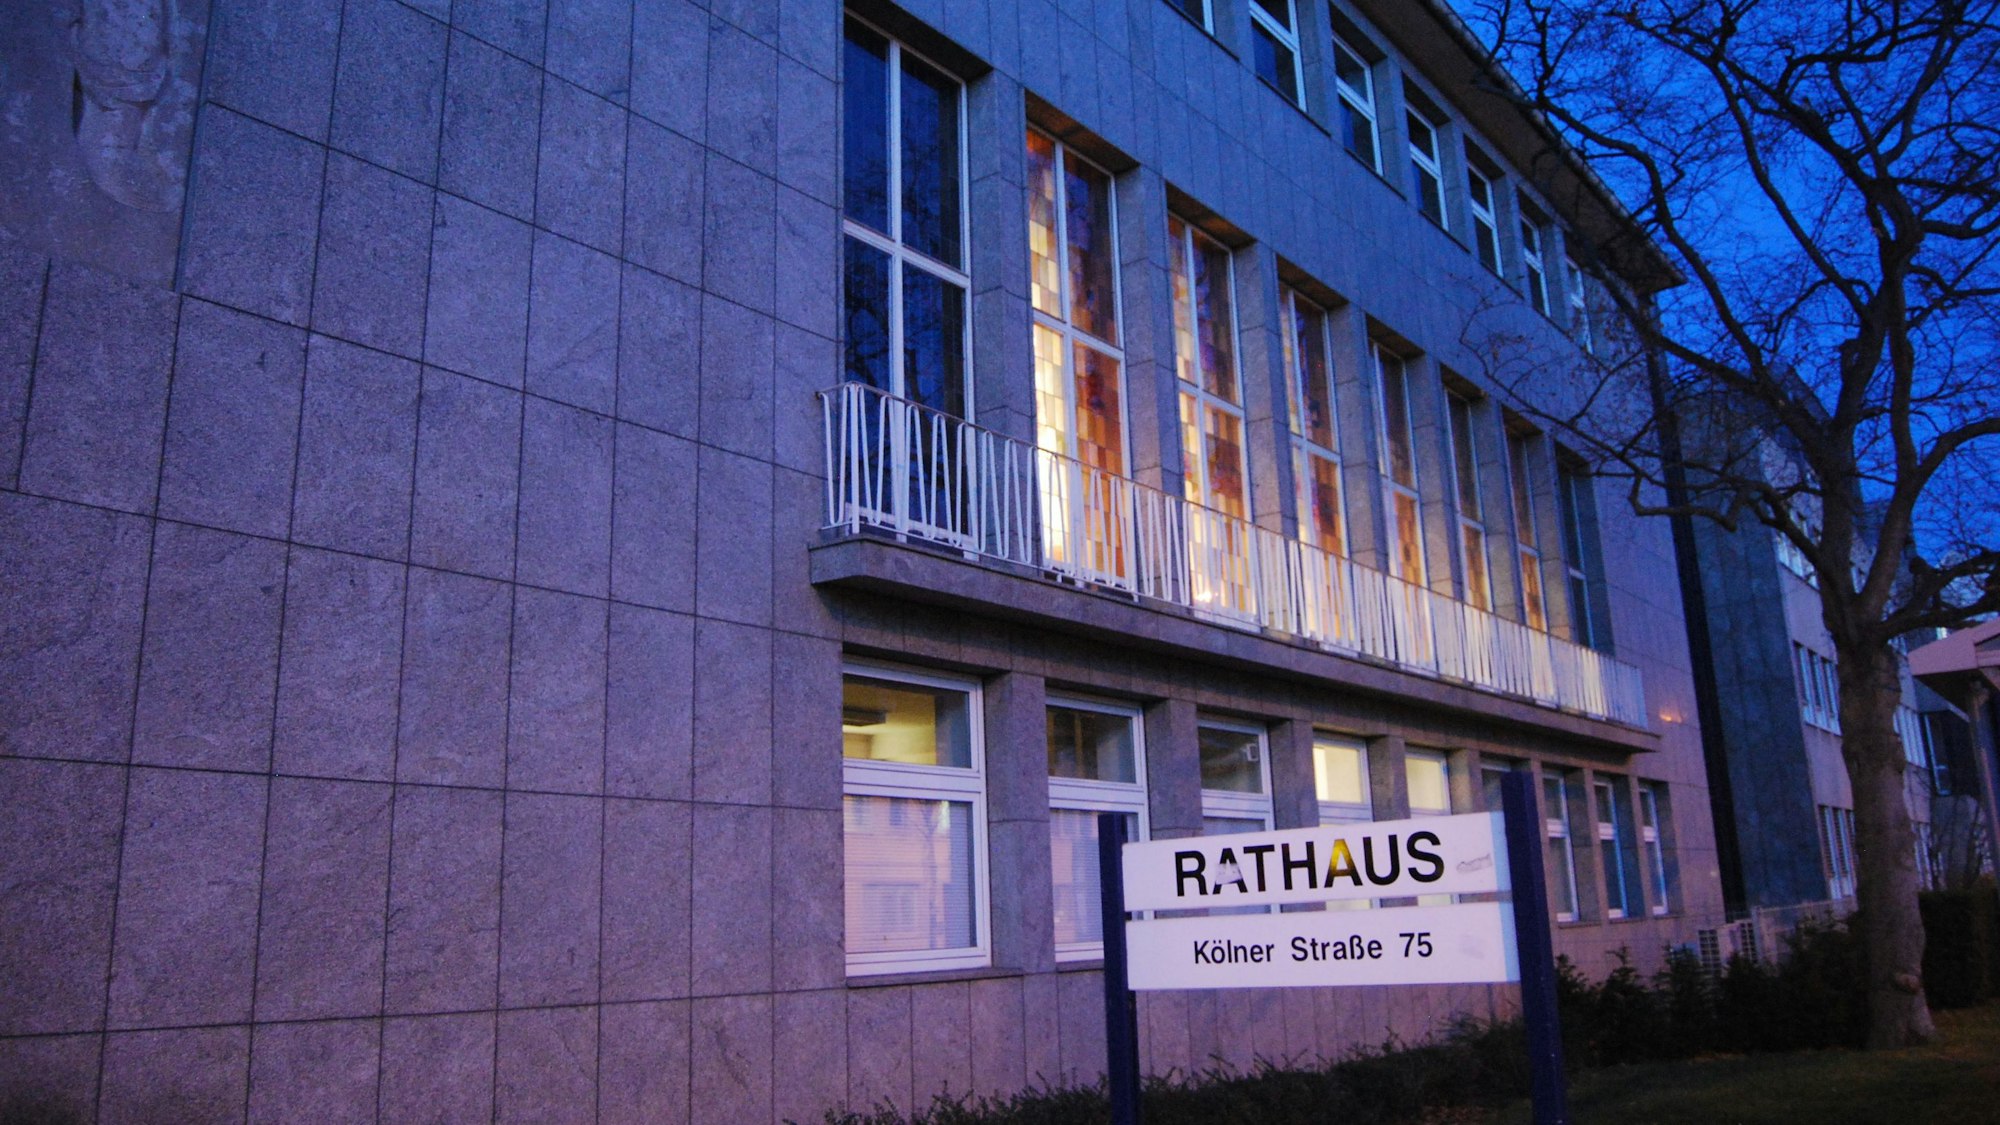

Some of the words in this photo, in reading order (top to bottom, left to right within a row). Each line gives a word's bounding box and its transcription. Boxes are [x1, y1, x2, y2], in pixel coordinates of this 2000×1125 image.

[1174, 830, 1446, 897] RATHAUS
[1193, 938, 1275, 965] Kölner
[1290, 935, 1383, 961] Straße
[1398, 932, 1434, 958] 75
